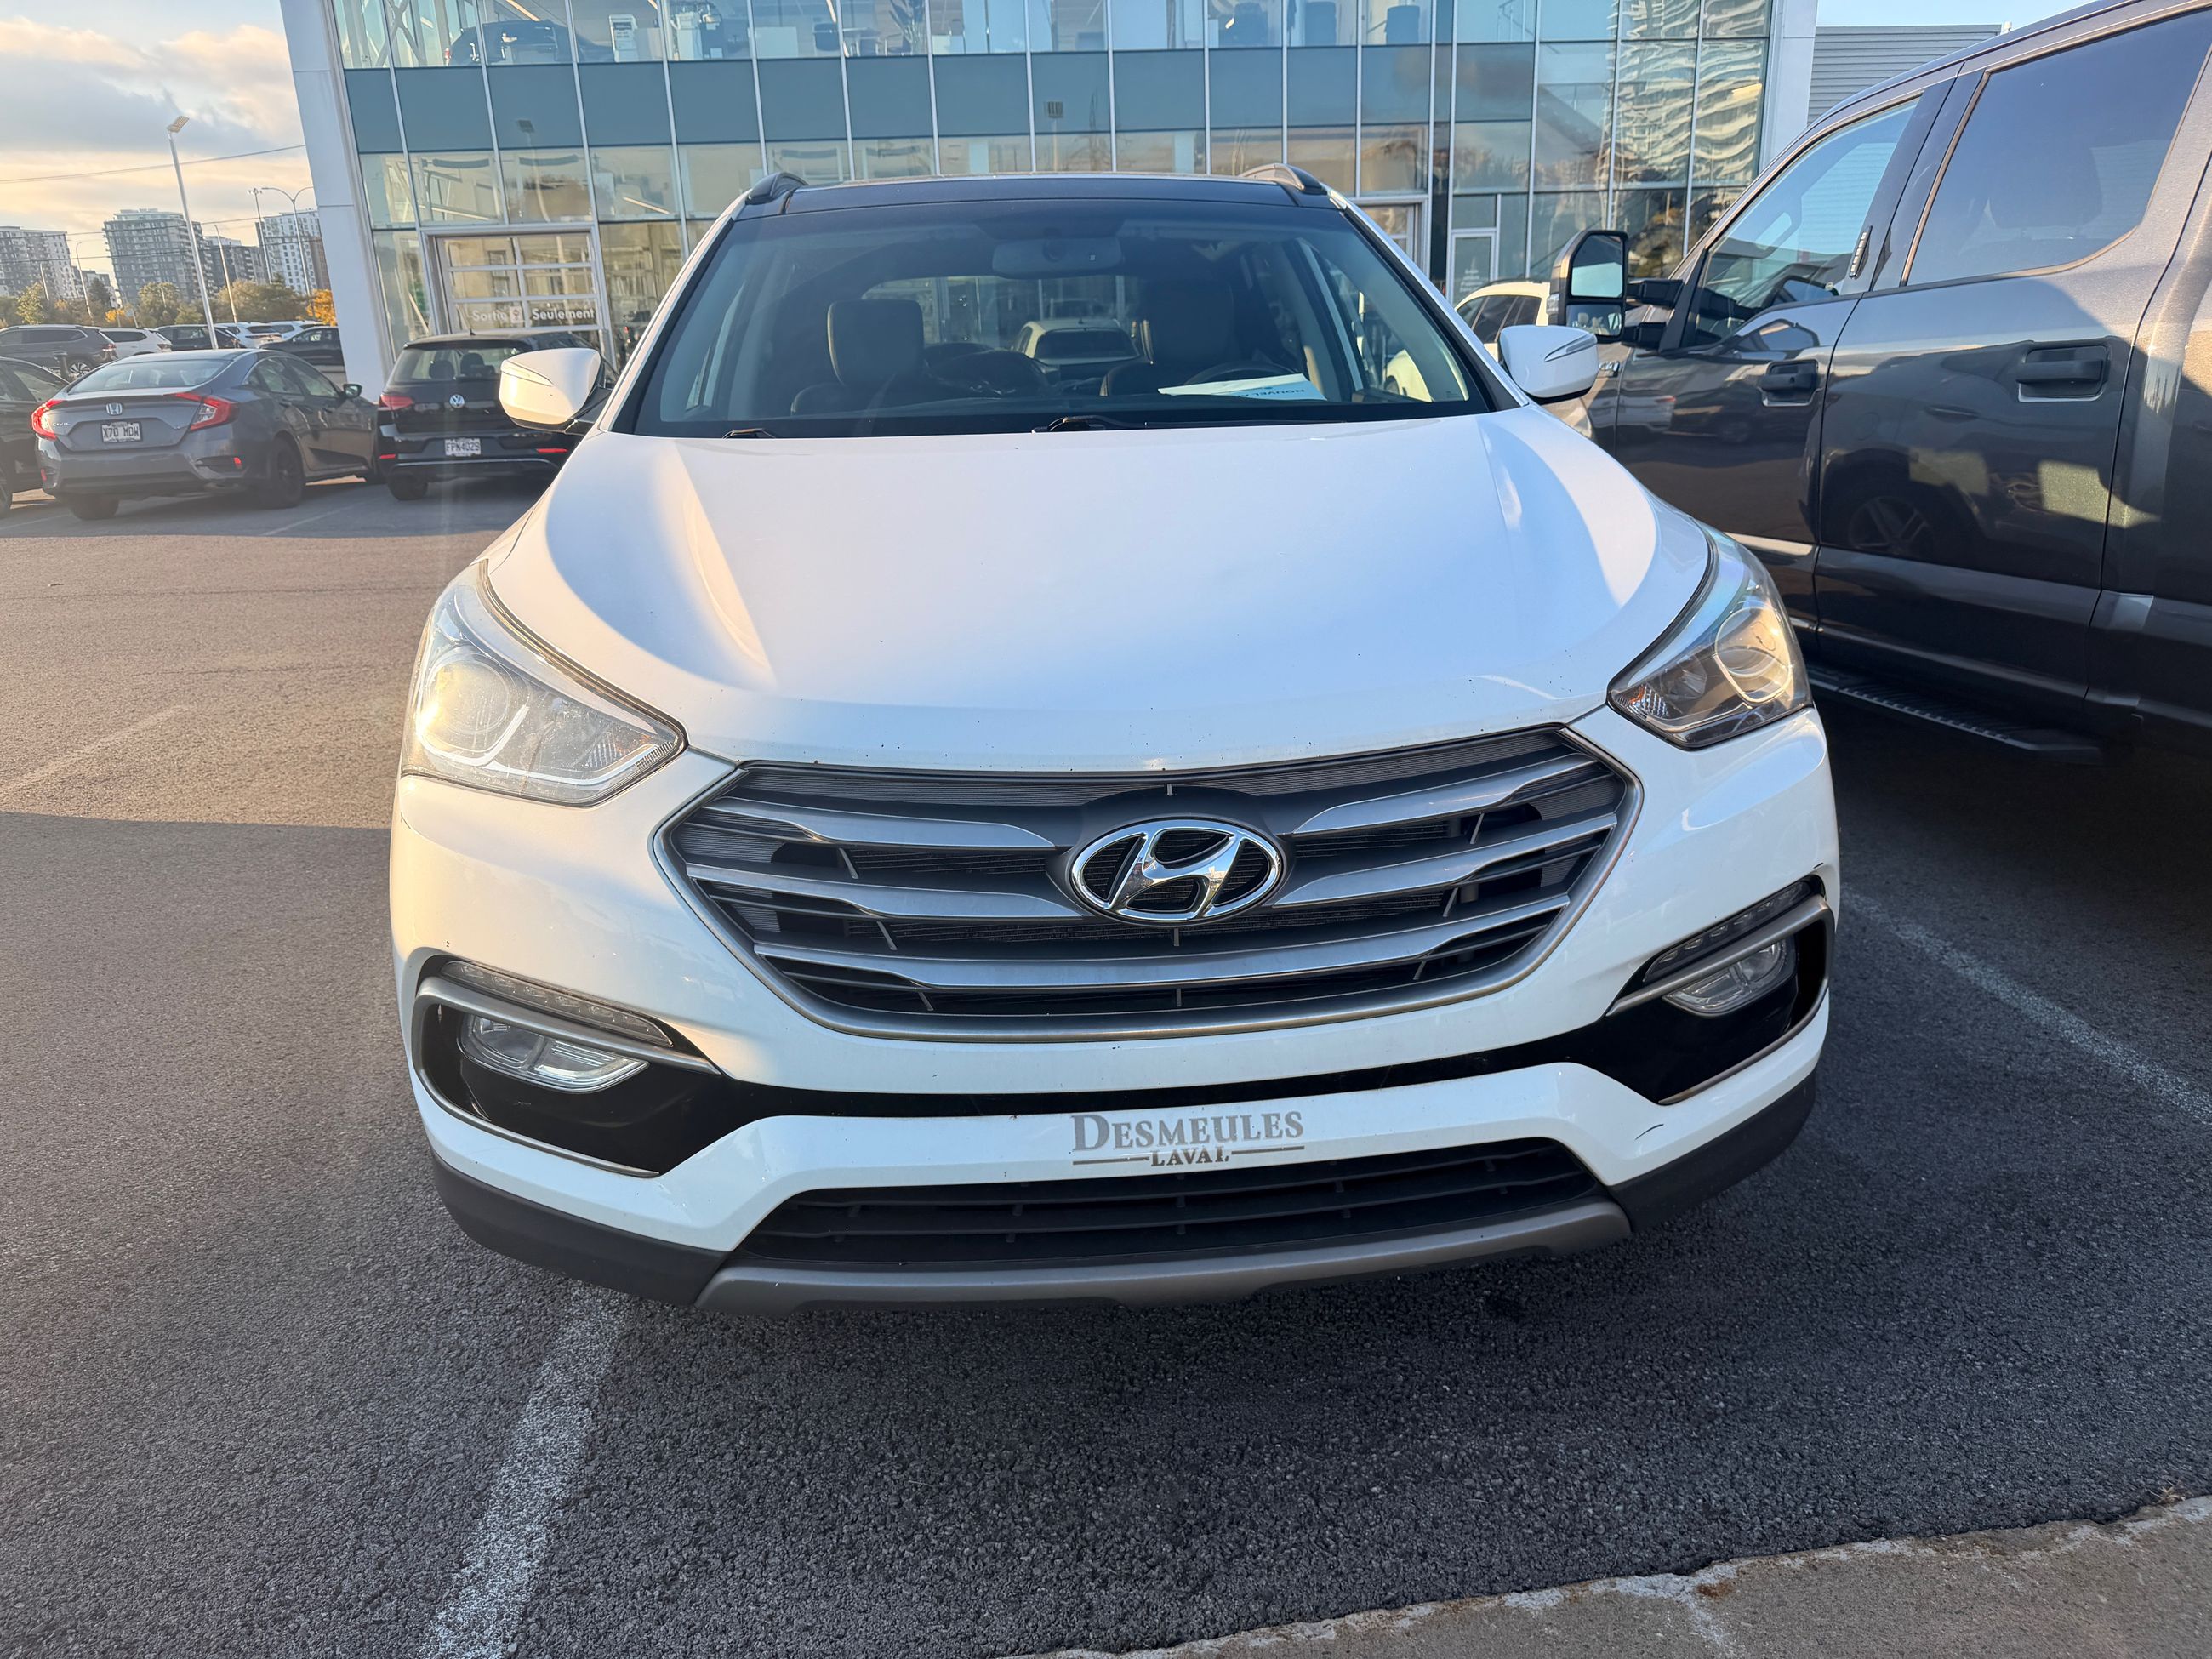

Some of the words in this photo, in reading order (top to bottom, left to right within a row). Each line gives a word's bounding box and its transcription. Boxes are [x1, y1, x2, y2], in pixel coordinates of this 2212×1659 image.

[472, 309, 508, 322] Sortie
[532, 306, 595, 321] Seulement
[1071, 1110, 1304, 1151] DESMEULES
[1150, 1146, 1229, 1167] LAVAL
